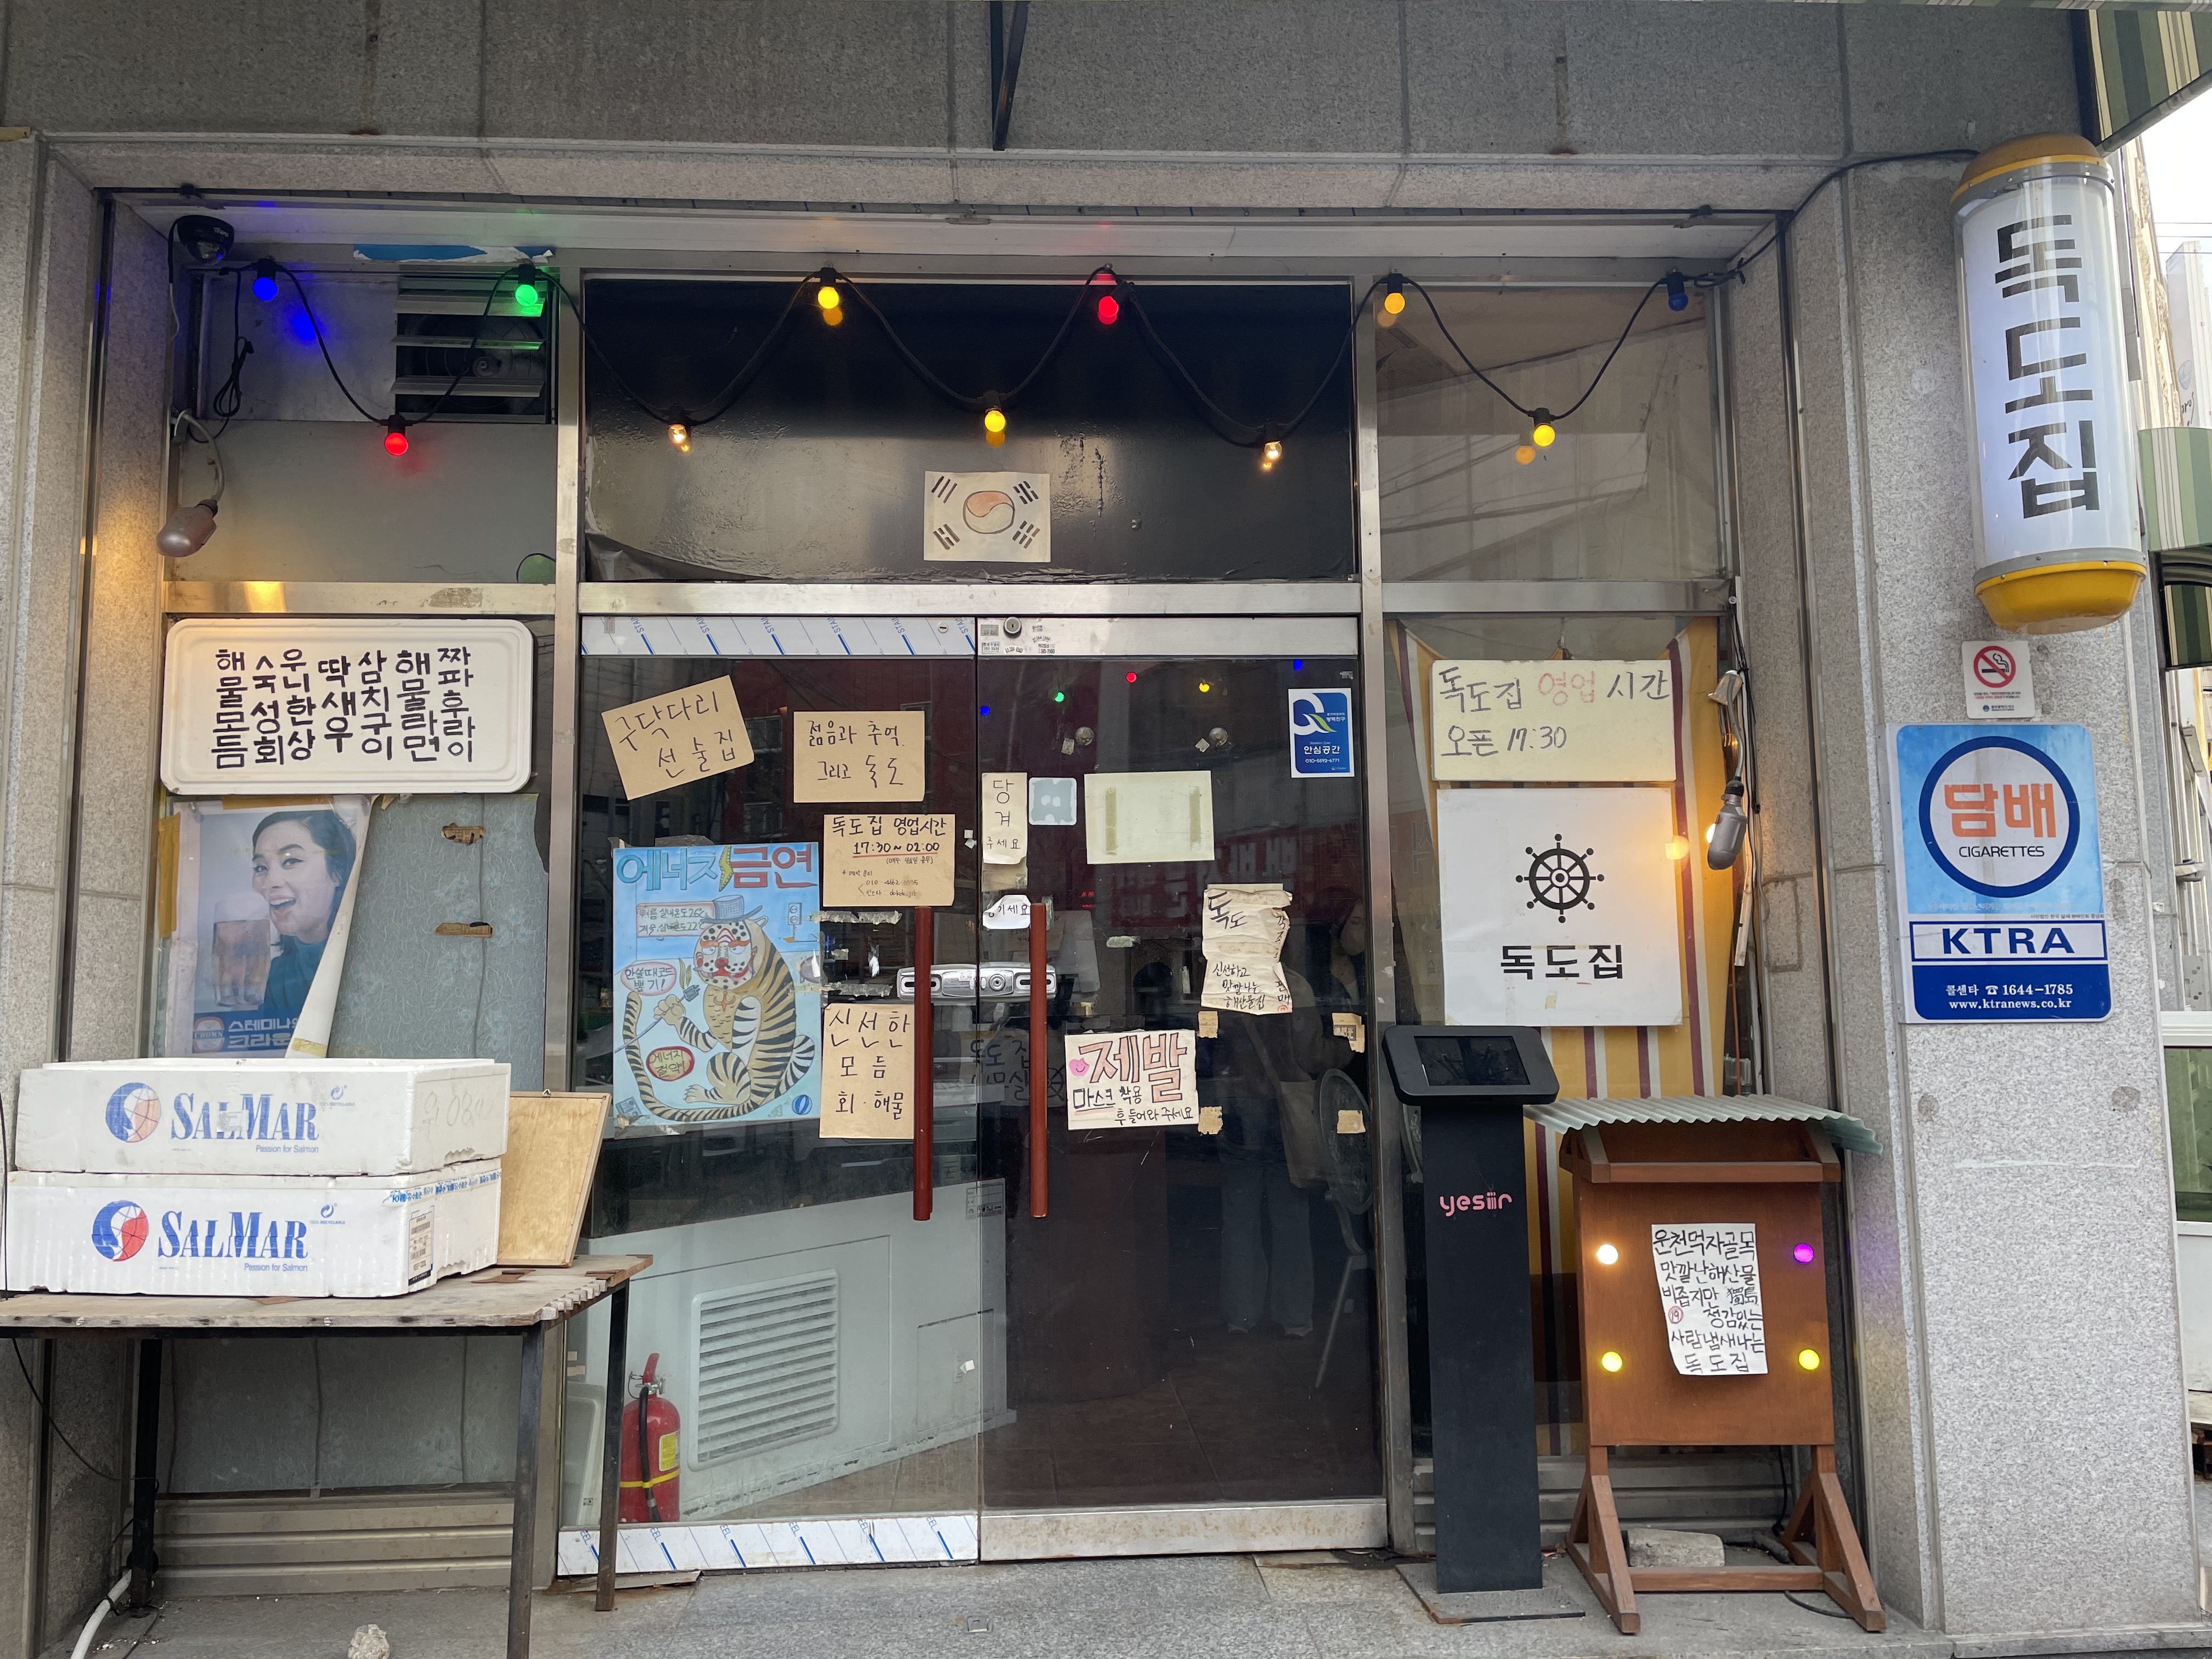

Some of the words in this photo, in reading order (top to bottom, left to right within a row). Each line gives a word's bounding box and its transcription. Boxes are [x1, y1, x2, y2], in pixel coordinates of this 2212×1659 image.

[1995, 215, 2100, 519] 독도집
[1439, 666, 1523, 712] 독도집
[1538, 671, 1596, 706] 영업
[1606, 670, 1671, 701] 시간
[318, 656, 357, 753] 딱새우
[358, 650, 392, 760] 삼치구이
[616, 691, 719, 751] 구닥다리
[806, 720, 857, 747] 젊음과
[1304, 746, 1341, 755] 안심공간
[1441, 725, 1498, 757] 오픈
[1506, 726, 1567, 752] 17:30
[817, 760, 851, 781] 그리고
[865, 754, 904, 788] 독도
[1944, 783, 2057, 839] 담배
[832, 816, 882, 837] 독도집
[986, 837, 1022, 850] 주세요
[1959, 845, 2045, 859] CIGARETTES
[1208, 891, 1248, 929] 독도
[1943, 927, 2075, 955] KTRA
[1212, 962, 1251, 977] 신선하고
[1500, 944, 1624, 980] 독도집
[1945, 984, 1979, 997] 콜센타
[2002, 984, 2074, 996] 1644-1785
[1949, 997, 2073, 1011] www.ktranews.co.kr
[194, 1030, 224, 1039] CROWN
[829, 1008, 910, 1048] 신선한
[841, 1056, 887, 1079] 모듬
[1079, 1032, 1188, 1103] 제발
[1073, 1088, 1115, 1109] 마스크
[1120, 1085, 1143, 1105] 착용
[1161, 1106, 1194, 1122] 주세요
[256, 1144, 281, 1153] Passion
[283, 1145, 292, 1153] for
[294, 1145, 319, 1153] Salmon
[244, 1263, 270, 1272] Passion
[272, 1263, 281, 1272] for
[283, 1263, 308, 1272] Salmon
[1662, 1284, 1719, 1309] 비좁지만
[1685, 1352, 1750, 1374] 독도집
